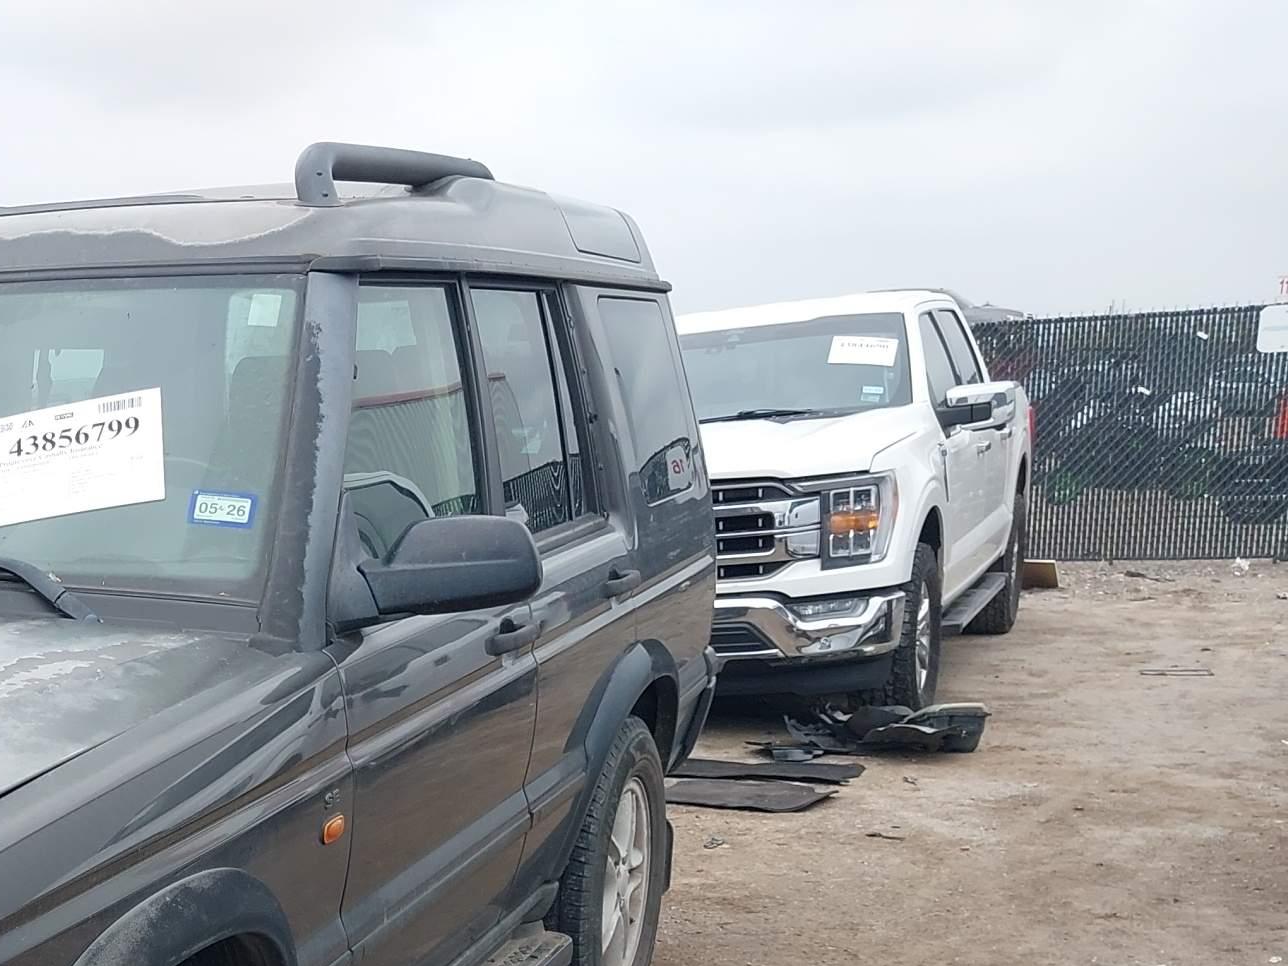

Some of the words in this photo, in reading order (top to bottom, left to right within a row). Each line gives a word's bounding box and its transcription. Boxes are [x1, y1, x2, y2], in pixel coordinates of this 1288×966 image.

[9, 416, 140, 457] 43856799
[198, 501, 218, 515] 05
[226, 504, 247, 518] 26
